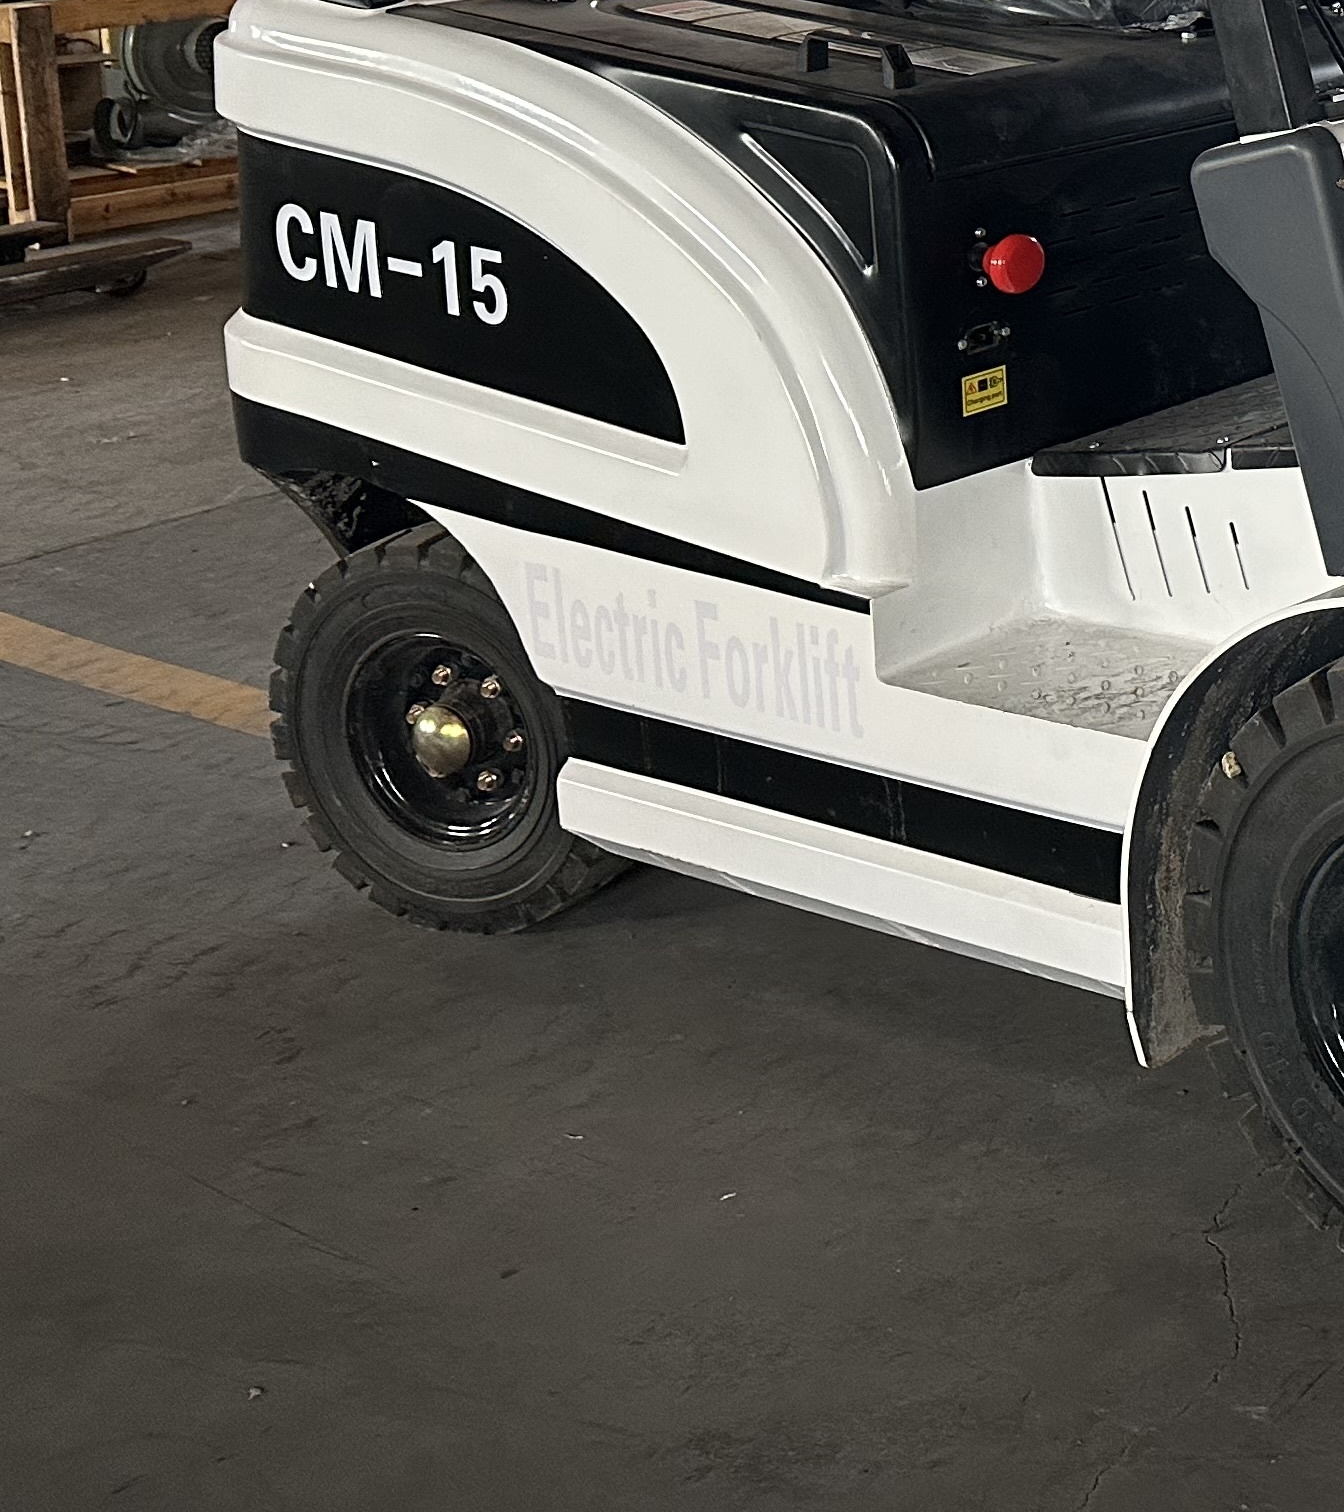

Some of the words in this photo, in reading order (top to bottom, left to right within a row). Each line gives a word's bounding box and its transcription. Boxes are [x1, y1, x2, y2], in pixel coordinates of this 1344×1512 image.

[275, 203, 509, 326] CM-15
[524, 561, 688, 693] Electric
[694, 599, 865, 738] Forklift
